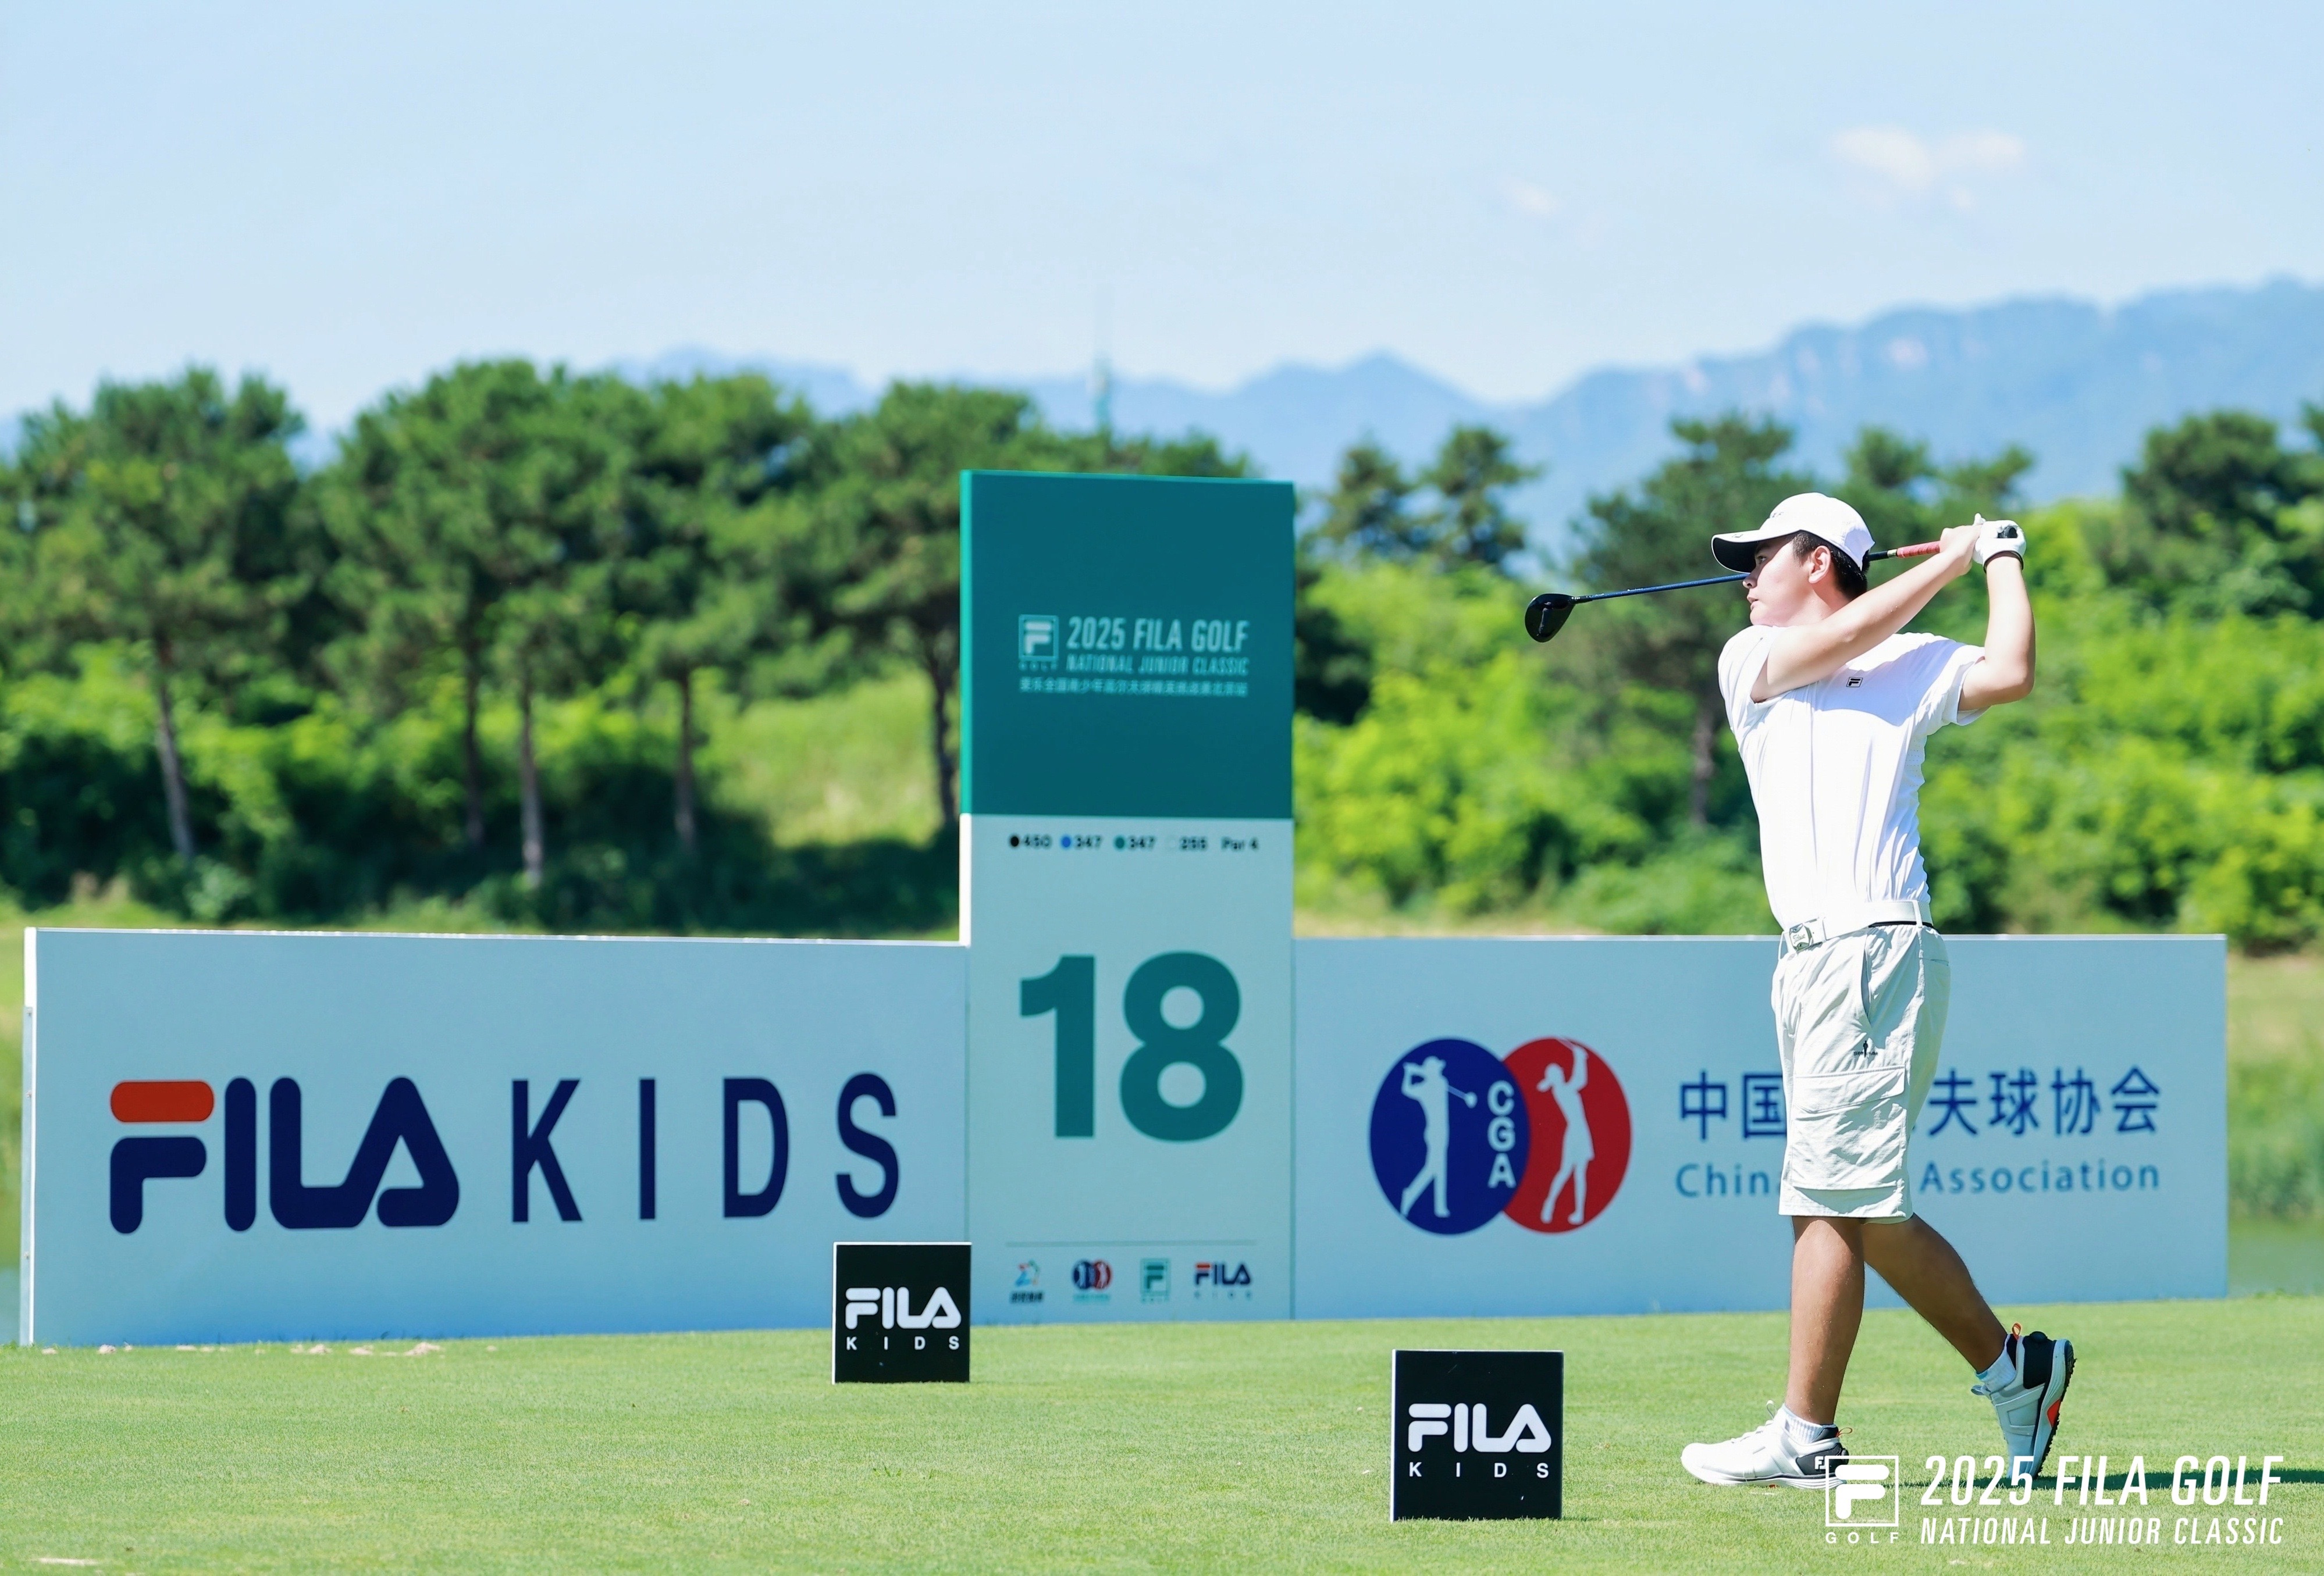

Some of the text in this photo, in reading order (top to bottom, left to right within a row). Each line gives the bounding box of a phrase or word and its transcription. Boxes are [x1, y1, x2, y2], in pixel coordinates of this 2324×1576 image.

[1067, 616, 1250, 652] 2025 FILA GOLF
[1066, 654, 1134, 673] NATIONAL
[1193, 657, 1250, 676] CLASSIC
[1023, 834, 1052, 850] 450
[1074, 835, 1102, 850] 347
[1128, 835, 1156, 851] 347
[1222, 836, 1245, 851] Par
[1020, 950, 1244, 1142] 18
[1680, 1058, 2159, 1141] 中国夫球协会
[110, 1072, 899, 1234] FILA KIDS
[1487, 1080, 1517, 1189] CGA
[1676, 1160, 2159, 1198] Chin Association
[1195, 1261, 1252, 1285] FILA
[845, 1286, 962, 1329] FILA
[846, 1336, 960, 1350] KIDS
[1408, 1403, 1551, 1453] FILA
[1409, 1461, 1549, 1478] KIDS
